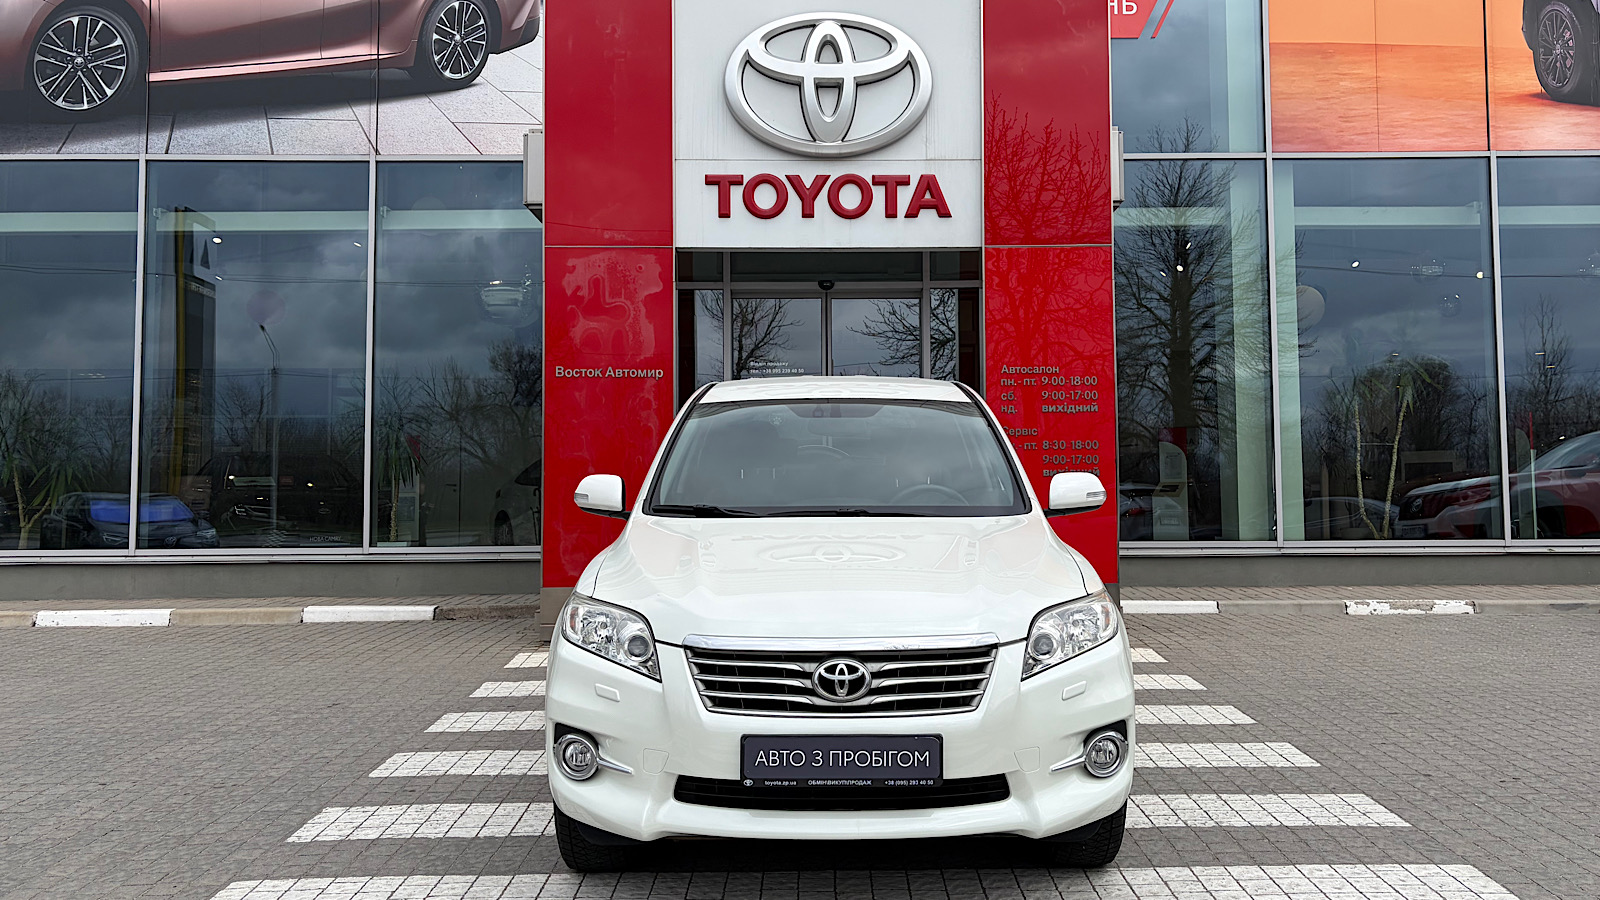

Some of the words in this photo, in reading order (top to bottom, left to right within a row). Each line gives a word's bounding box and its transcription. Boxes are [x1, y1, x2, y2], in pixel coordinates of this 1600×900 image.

[705, 173, 952, 219] TOYOTA
[555, 366, 602, 378] Восток
[605, 366, 664, 381] Автомир
[1001, 365, 1060, 374] Автосалон
[1001, 391, 1017, 400] сб.
[1001, 405, 1018, 414] нд.
[1042, 402, 1099, 414] вихідний
[755, 750, 806, 767] АВТО
[829, 750, 930, 767] ПРОБІГОМ
